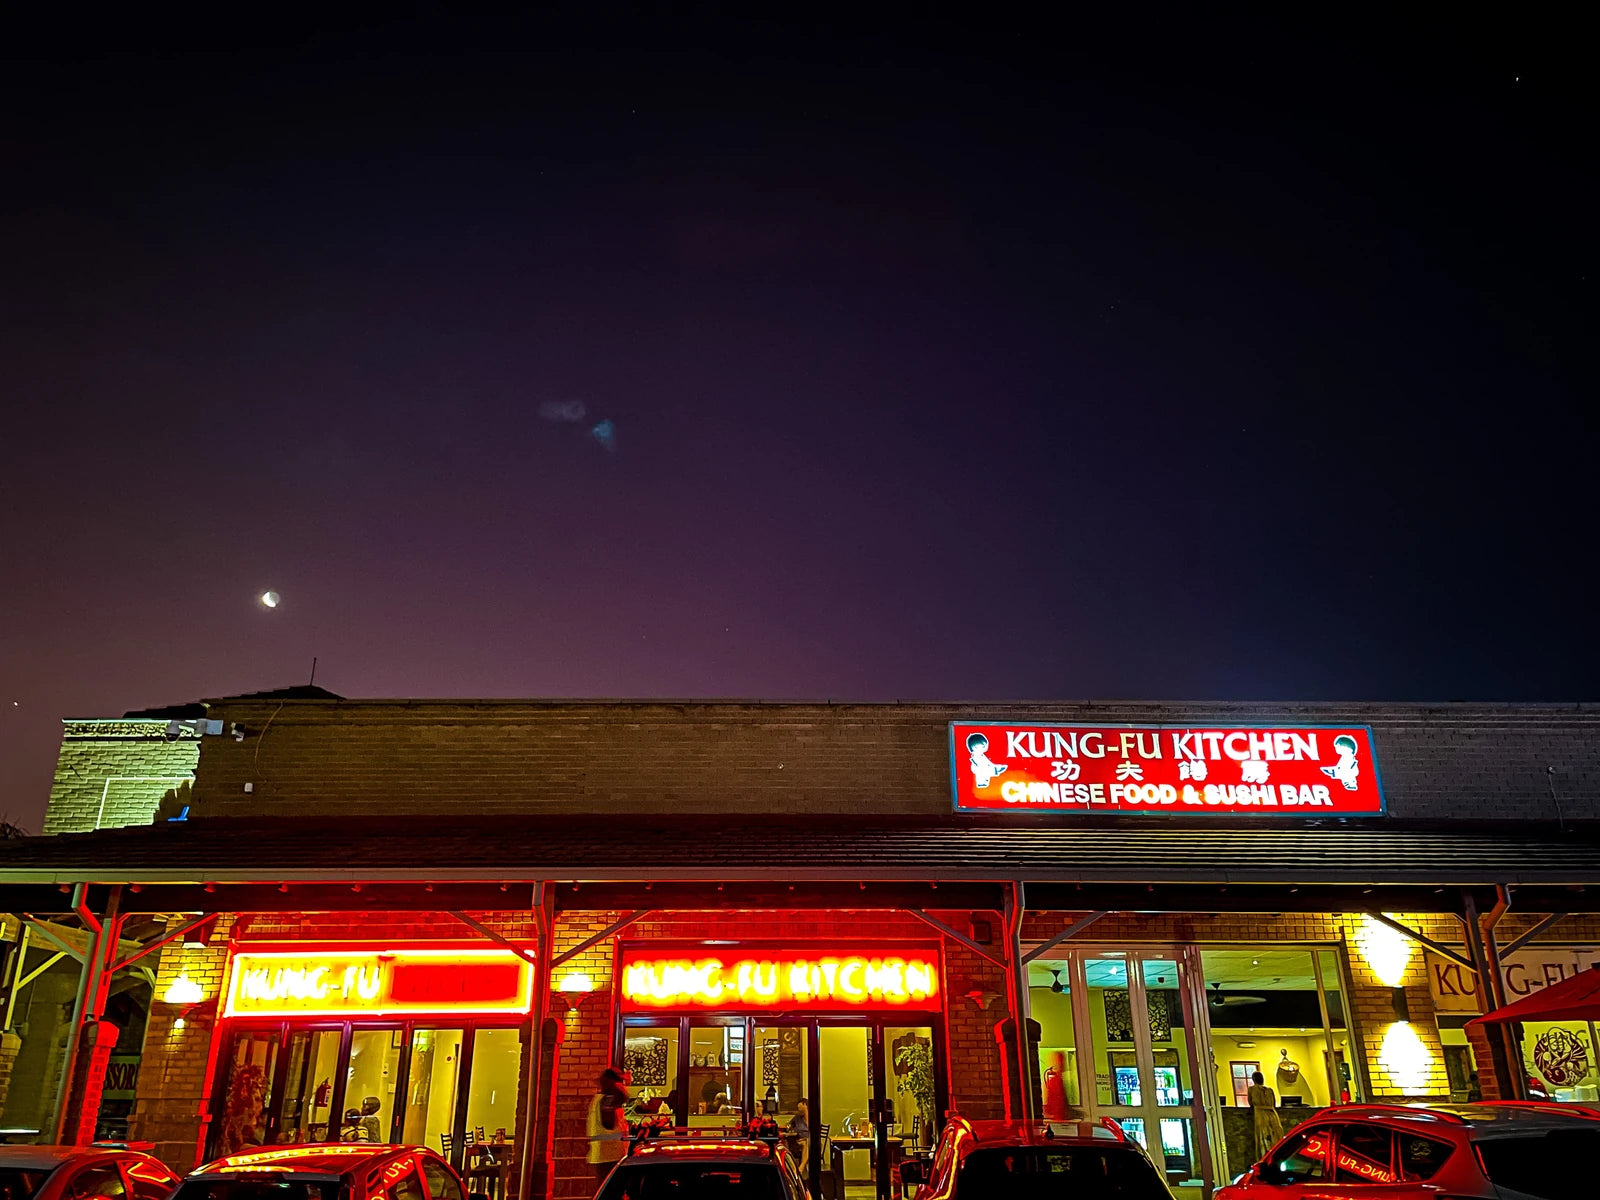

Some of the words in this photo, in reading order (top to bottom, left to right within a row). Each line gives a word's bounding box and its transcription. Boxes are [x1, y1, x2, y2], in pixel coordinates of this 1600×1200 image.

[1005, 730, 1163, 759] KUNG-FU
[1172, 731, 1320, 761] KITCHEN
[1001, 780, 1106, 804] CHINESE
[1109, 782, 1178, 805] FOOD
[1182, 784, 1203, 805] &
[1203, 784, 1278, 806] SUSHI
[1279, 784, 1334, 806] BAR
[240, 965, 381, 1001] KUNG-FU
[625, 961, 776, 1000] KUNG-FU
[788, 960, 932, 997] KITCHEN
[1434, 963, 1580, 996] KUG-F
